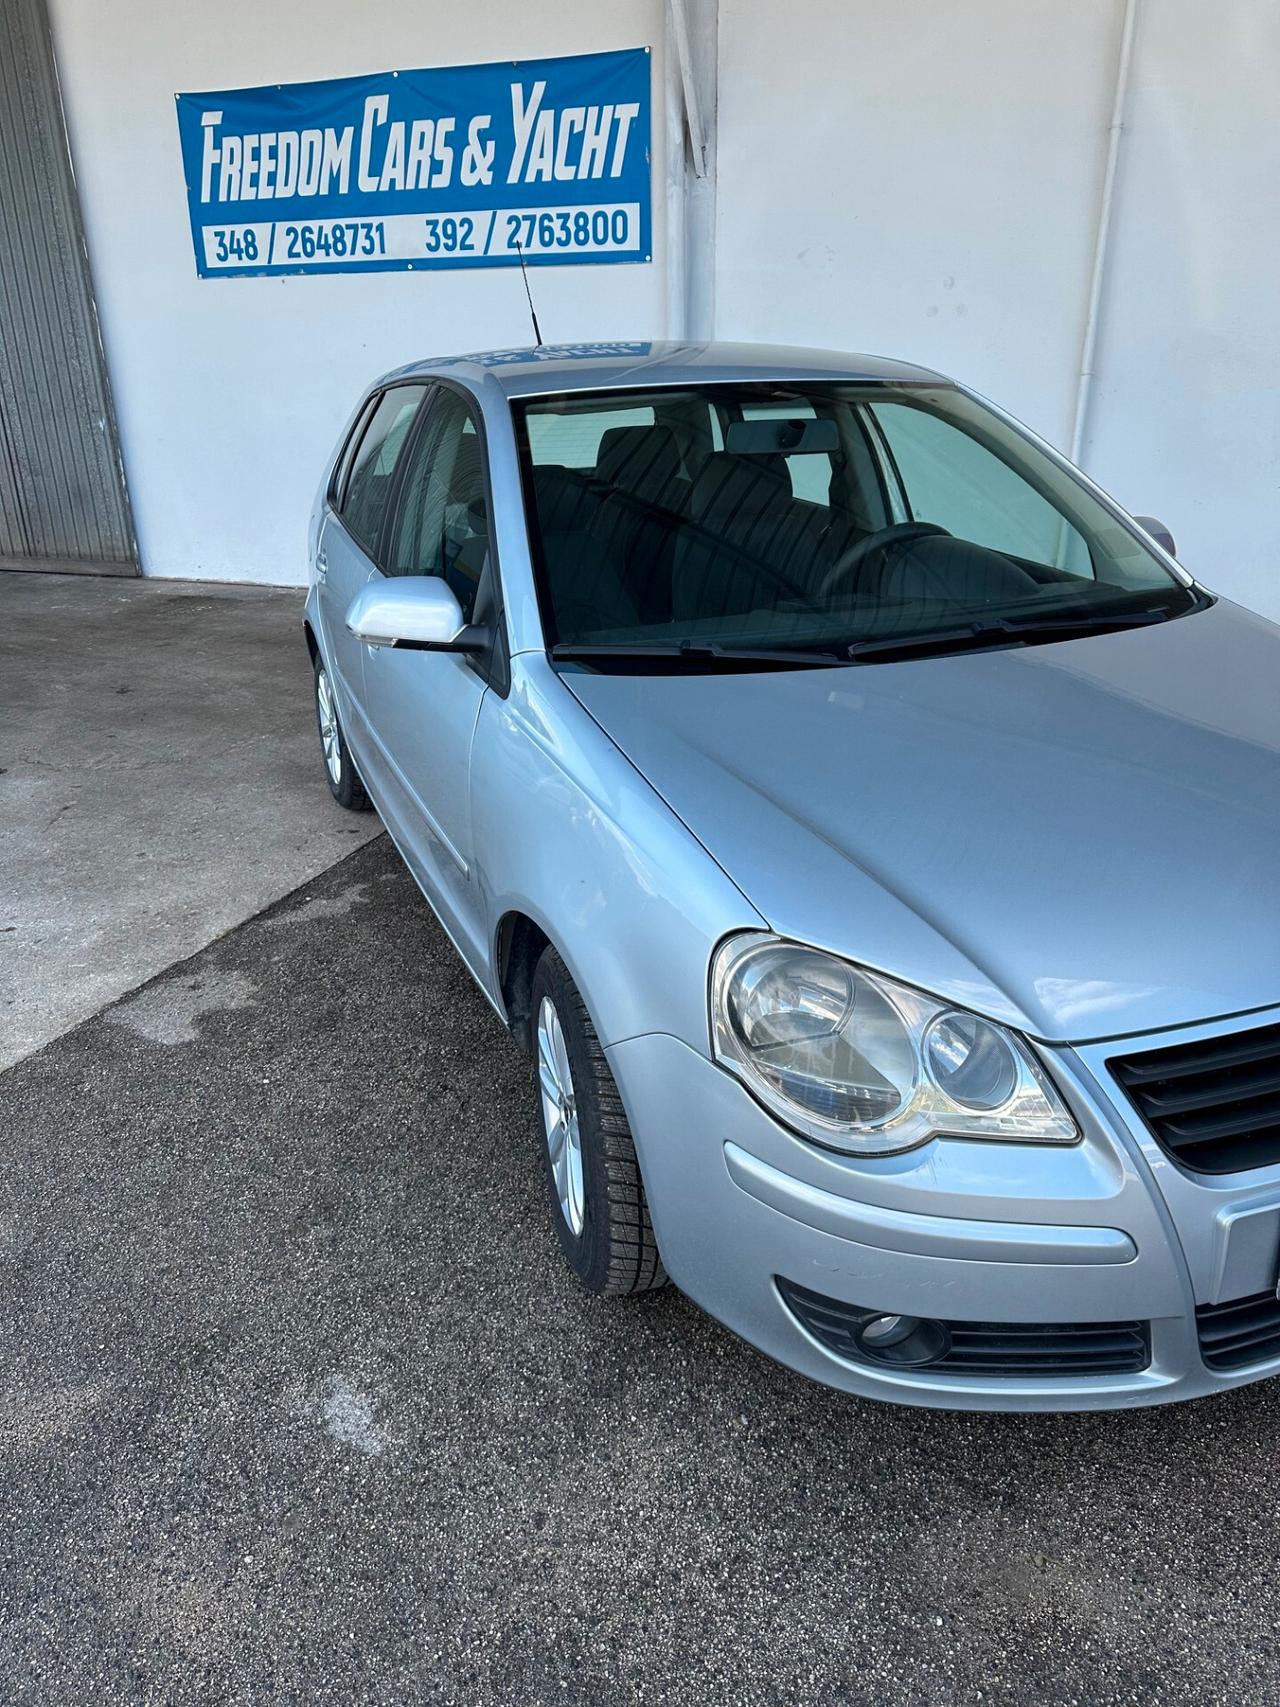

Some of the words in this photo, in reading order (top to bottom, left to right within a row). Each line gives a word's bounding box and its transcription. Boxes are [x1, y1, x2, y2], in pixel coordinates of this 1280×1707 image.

[201, 111, 354, 203] FREEDOM
[358, 94, 456, 193] CARS
[461, 115, 495, 186] &
[506, 81, 640, 184] YACHT
[214, 228, 258, 262] 348
[286, 222, 386, 259] 2648731
[426, 218, 474, 252] 392
[506, 209, 628, 249] 2763800
